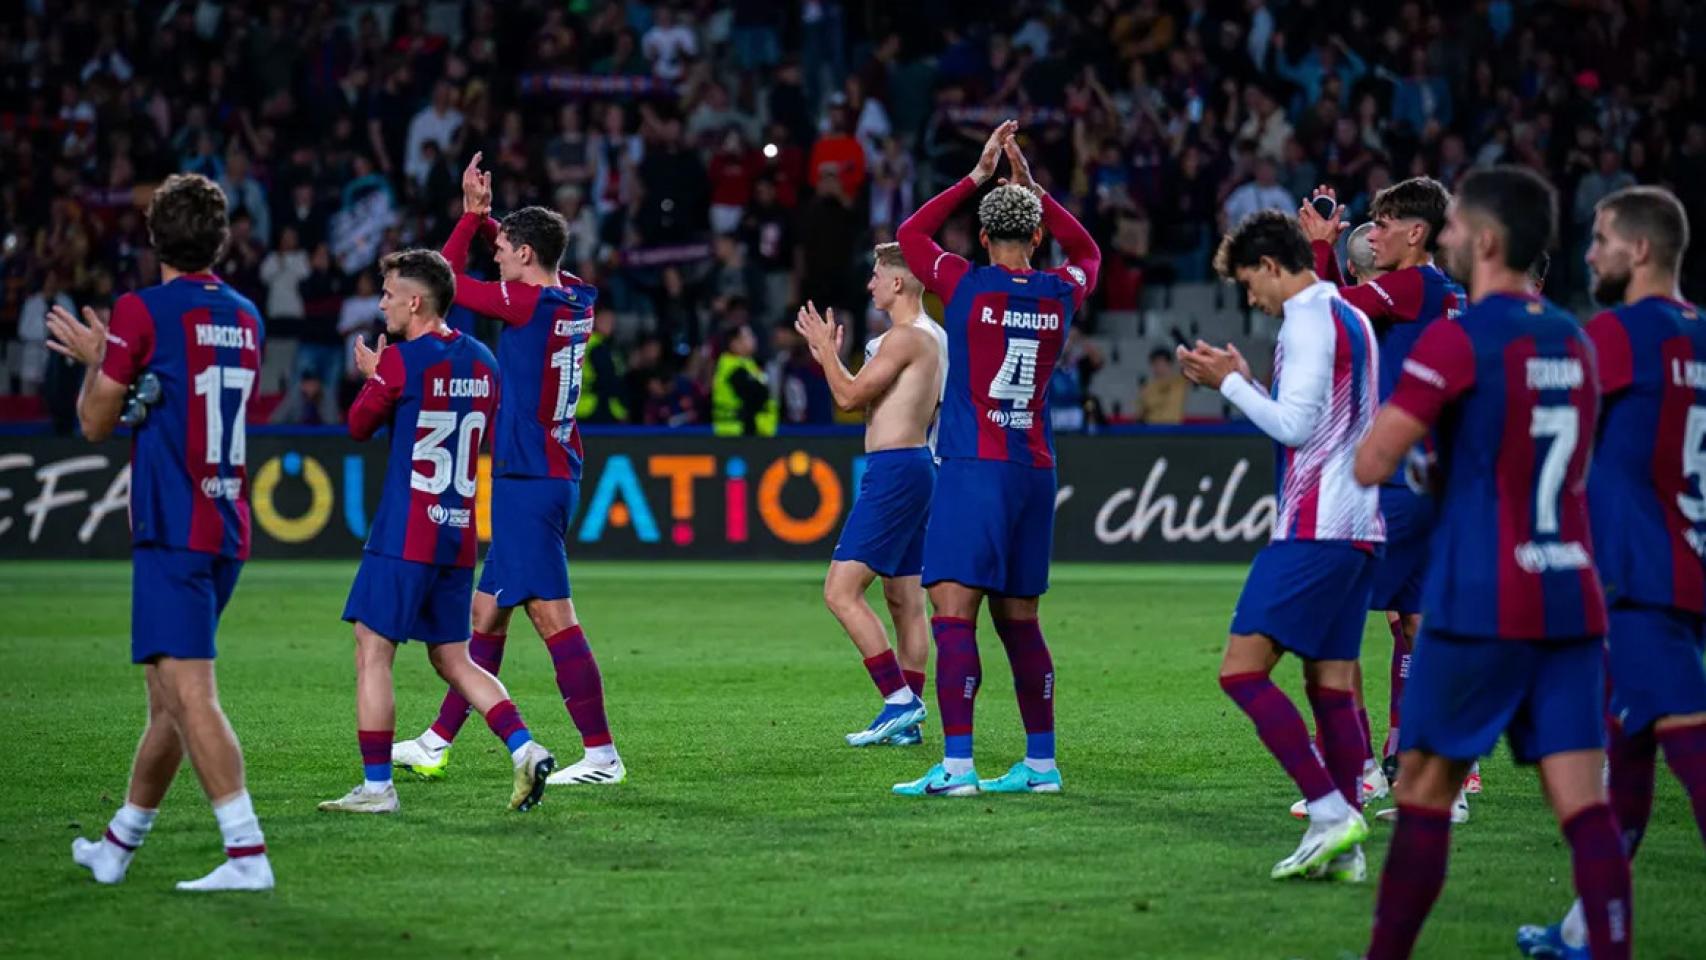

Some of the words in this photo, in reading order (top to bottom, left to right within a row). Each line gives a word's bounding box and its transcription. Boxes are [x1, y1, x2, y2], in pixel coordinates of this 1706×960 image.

[195, 323, 244, 349] MARCOS
[981, 306, 997, 325] R.
[1001, 307, 1059, 331] ARAUJO
[449, 374, 489, 398] CASADÓ
[988, 337, 1040, 409] 4
[194, 365, 256, 466] 17
[410, 410, 487, 498] 30
[1530, 406, 1579, 534] 7
